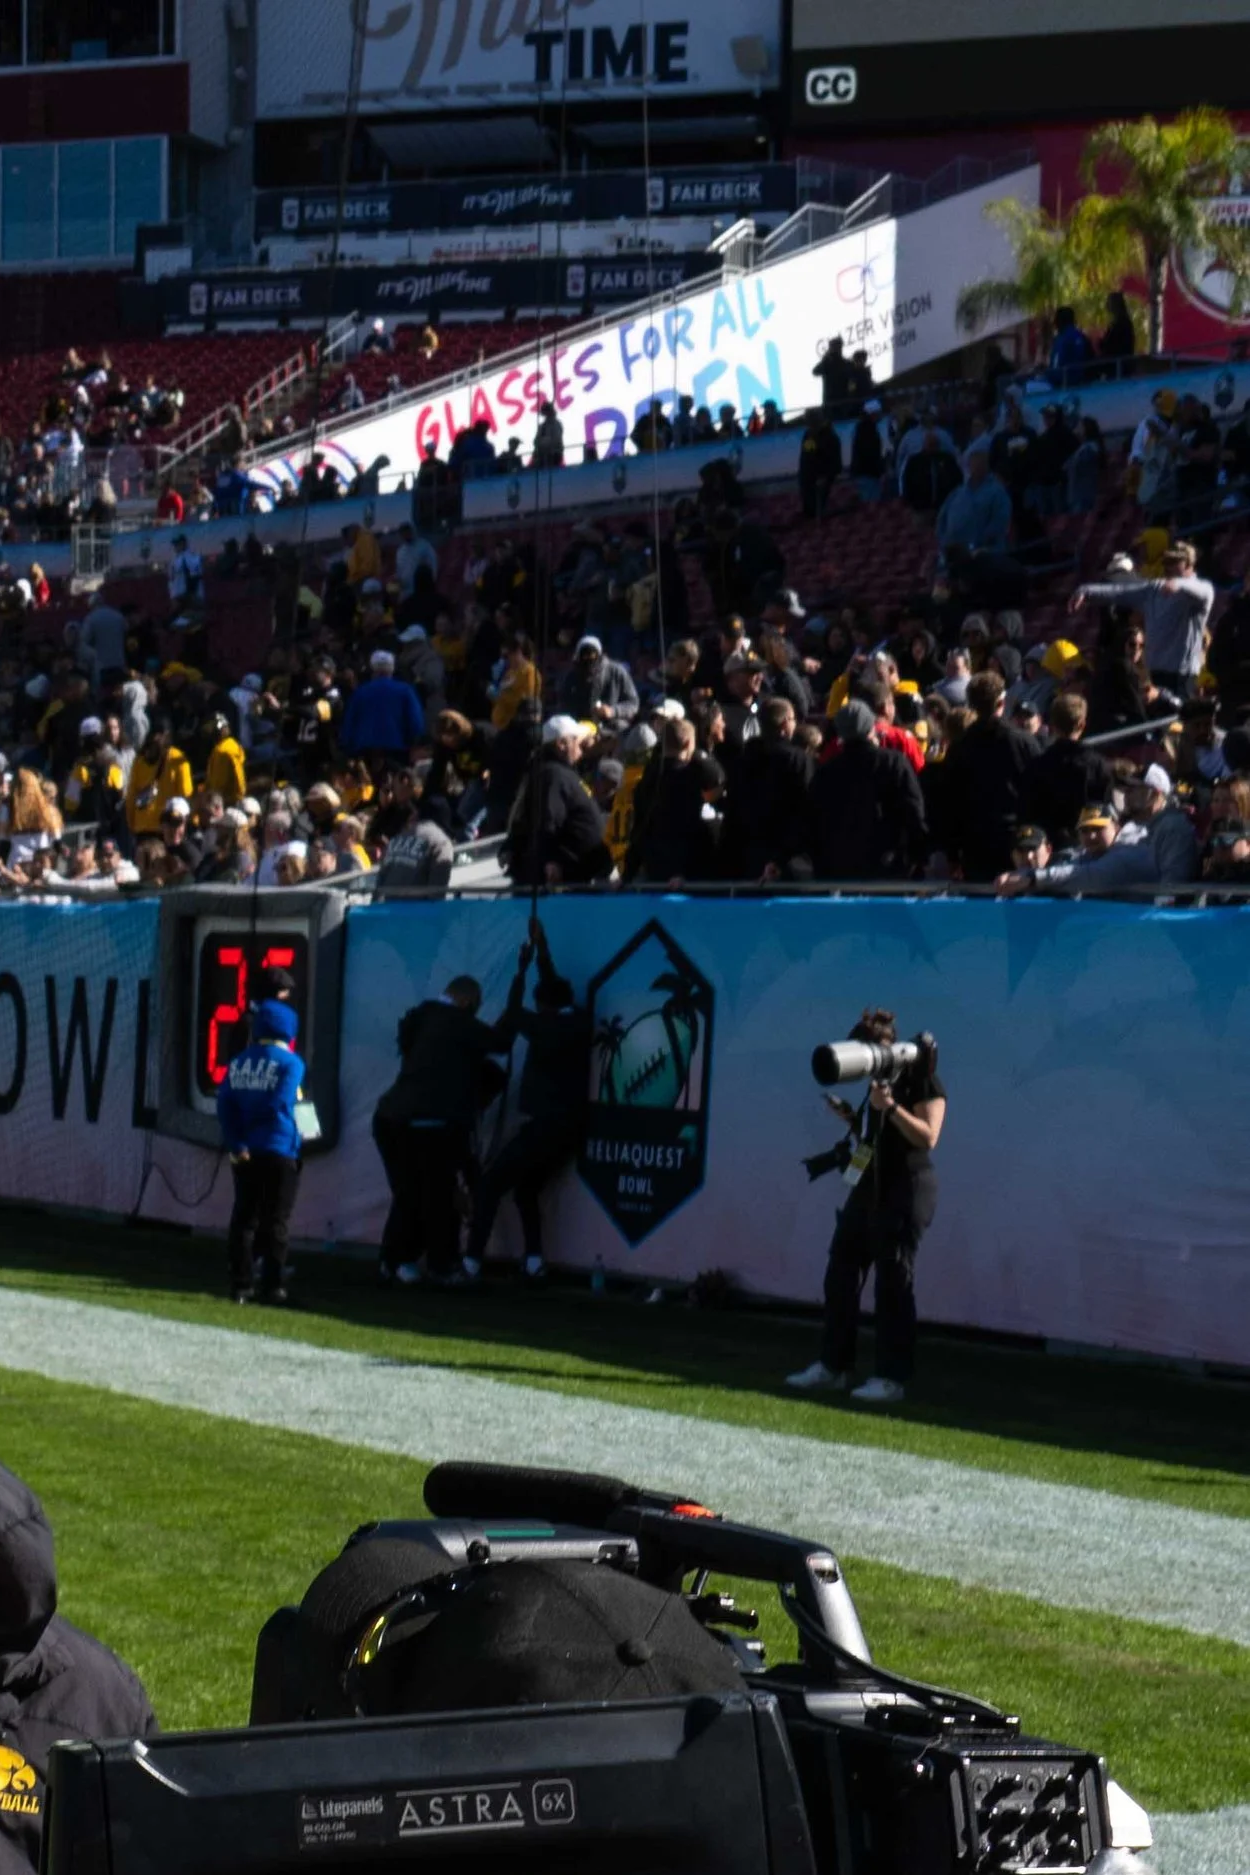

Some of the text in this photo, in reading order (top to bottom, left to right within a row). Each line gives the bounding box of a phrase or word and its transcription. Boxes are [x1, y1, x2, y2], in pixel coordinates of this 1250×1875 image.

[524, 22, 688, 82] TIME
[810, 73, 852, 99] CC
[671, 179, 762, 201] FAN DECK
[342, 199, 390, 219] DECK
[589, 270, 629, 289] FAN
[212, 284, 301, 307] FAN DECK
[416, 277, 775, 464] GLASSES FOR ALL
[586, 1138, 686, 1171] RELIAQUEST
[617, 1174, 655, 1197] BOWL
[319, 1794, 384, 1821] Litepanels
[399, 1791, 566, 1830] ASTRA 6X
